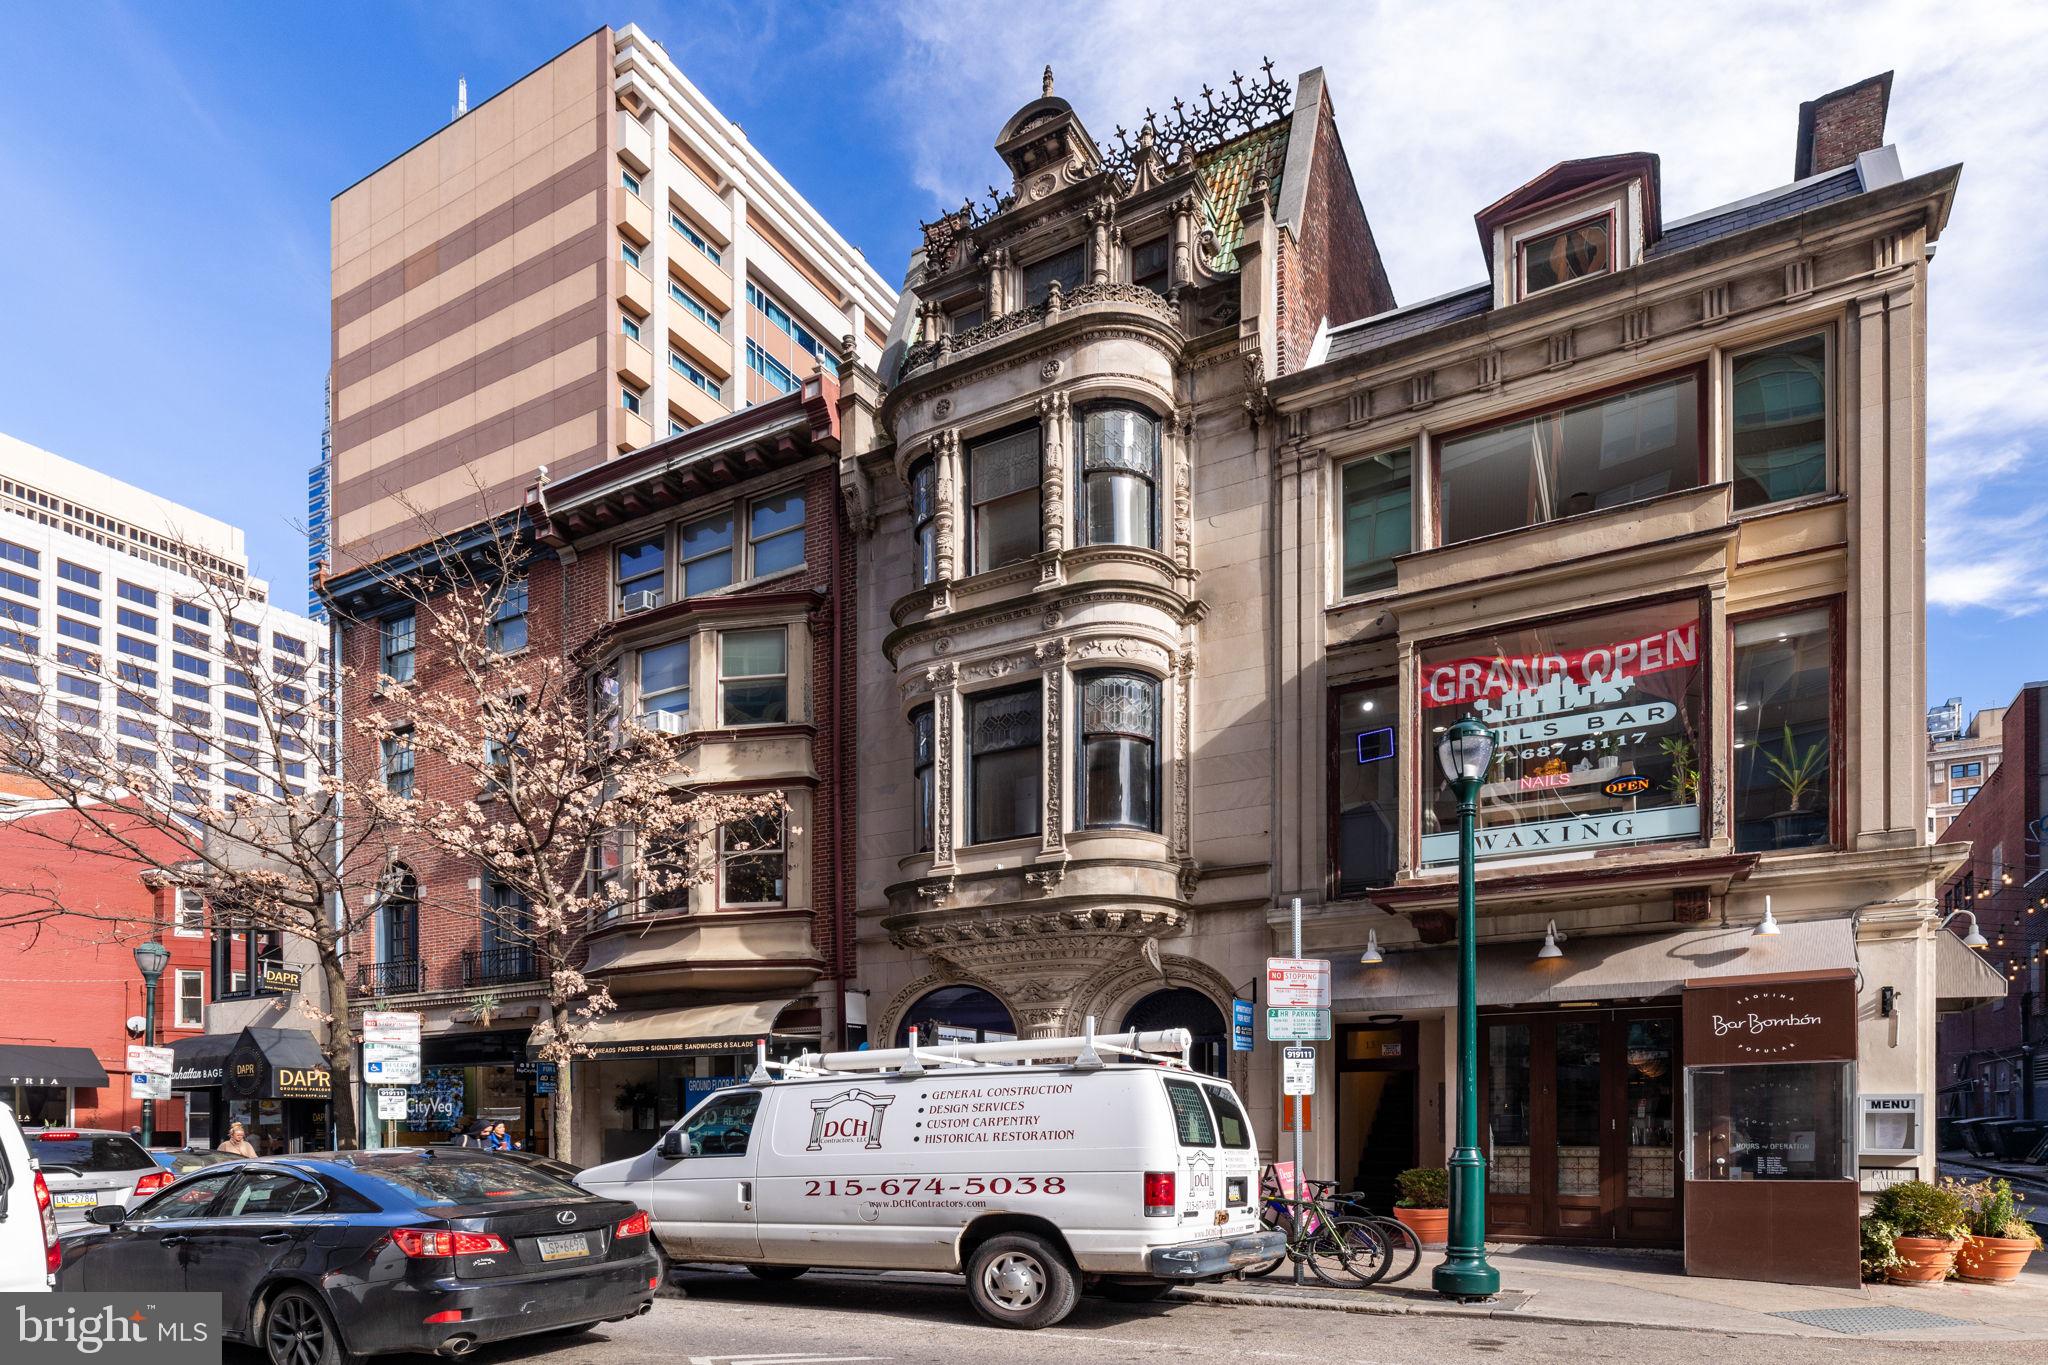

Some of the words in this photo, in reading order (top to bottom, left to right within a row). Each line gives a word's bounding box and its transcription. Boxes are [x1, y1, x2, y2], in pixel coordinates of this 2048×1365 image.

[1430, 655, 1568, 703] GRAND
[1581, 625, 1698, 682] OPEN
[1482, 685, 1633, 720] PHILLY
[1503, 722, 1558, 742] ILS
[1587, 707, 1665, 730] BAR
[1495, 732, 1648, 764] 7-687-8117
[1520, 773, 1571, 790] NAILS
[1605, 778, 1650, 794] OPEN
[1474, 819, 1634, 850] WAXING
[266, 970, 299, 984] DAPR
[1285, 972, 1317, 980] STOPPING
[1737, 993, 1795, 1004] ESQUINA
[1712, 1015, 1747, 1036] Bar
[1748, 1013, 1821, 1034] Bombón
[650, 1043, 683, 1051] SIGNATURE
[684, 1042, 722, 1050] SANDWICHES
[1738, 1043, 1795, 1053] POPULAR
[168, 1066, 202, 1080] anhattan
[237, 1063, 255, 1075] DAPR
[10, 1077, 59, 1085] TRIA
[280, 1069, 331, 1087] DAPR
[688, 1079, 711, 1091] GROUND
[932, 1088, 983, 1100] GENERAL
[987, 1084, 1073, 1097] CONSTRUCTION
[406, 1097, 453, 1117] CityVeg
[929, 1104, 968, 1115] DESIGN
[972, 1101, 1025, 1113] SERVICES
[1871, 1100, 1910, 1109] MENU
[823, 1117, 869, 1137] DCH
[927, 1118, 969, 1129] CUSTOM
[972, 1115, 1040, 1127] CARPENTRY
[925, 1132, 989, 1144] HISTORICAL
[992, 1129, 1075, 1142] RESTORATION
[805, 1177, 1067, 1196] 215-674-5038
[1194, 1173, 1210, 1187] DCH
[868, 1200, 987, 1209] www.DCHContractors.com
